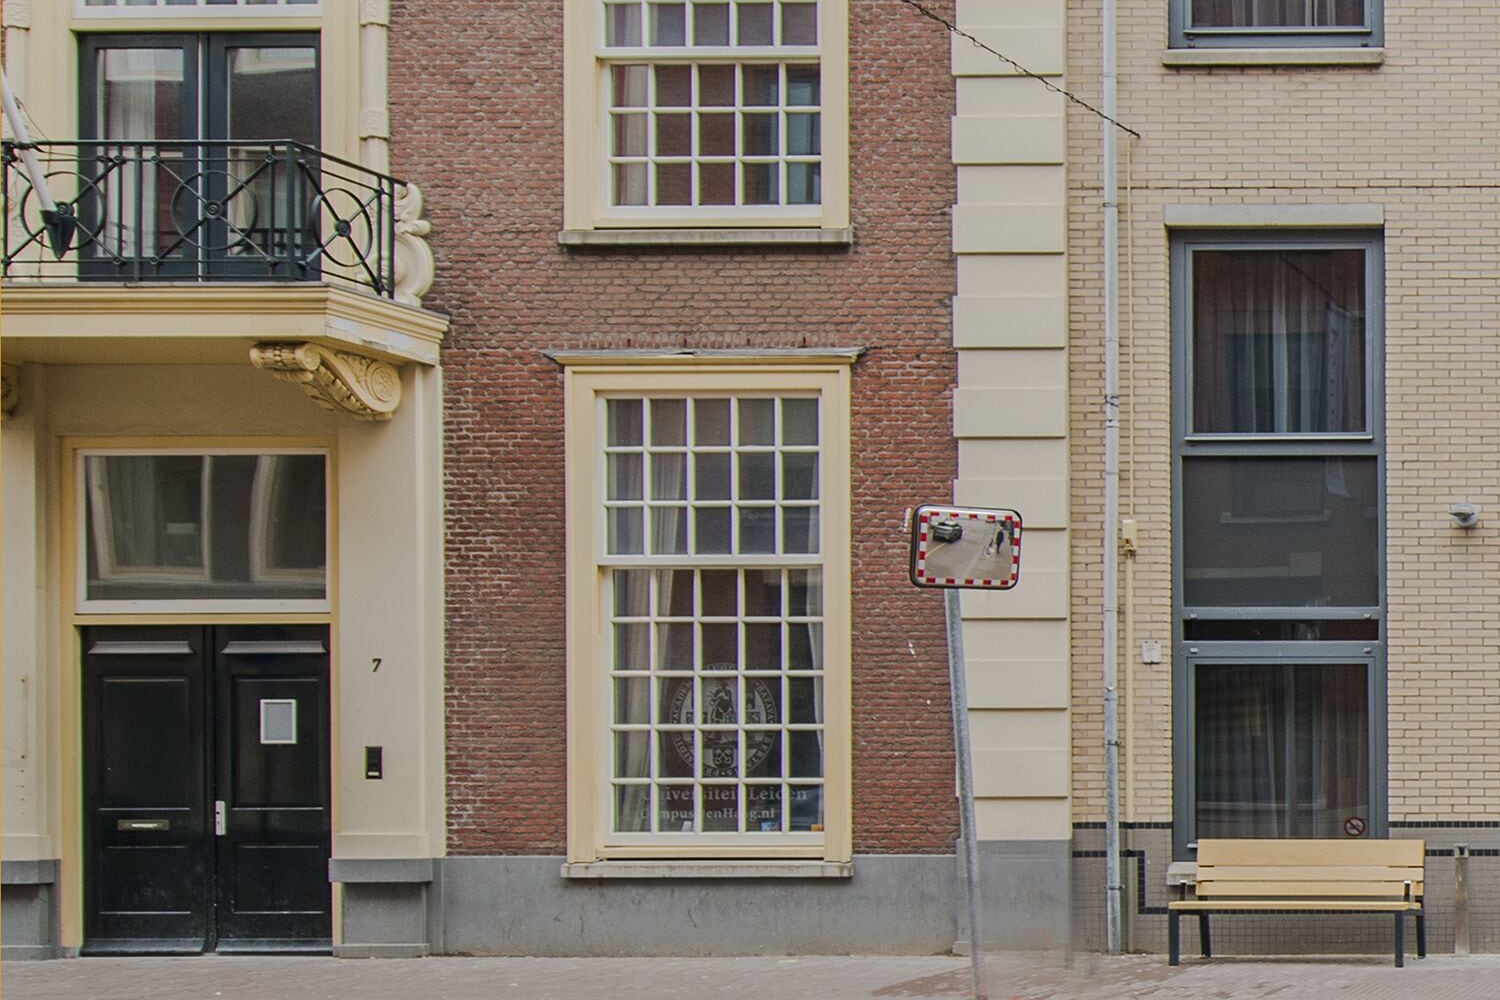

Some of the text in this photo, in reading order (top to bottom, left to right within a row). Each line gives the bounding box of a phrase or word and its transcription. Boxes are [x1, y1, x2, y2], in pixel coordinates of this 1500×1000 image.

[371, 657, 382, 673] 7
[641, 786, 743, 801] Uivesitei
[640, 807, 774, 821] CmpusenHg.nl
